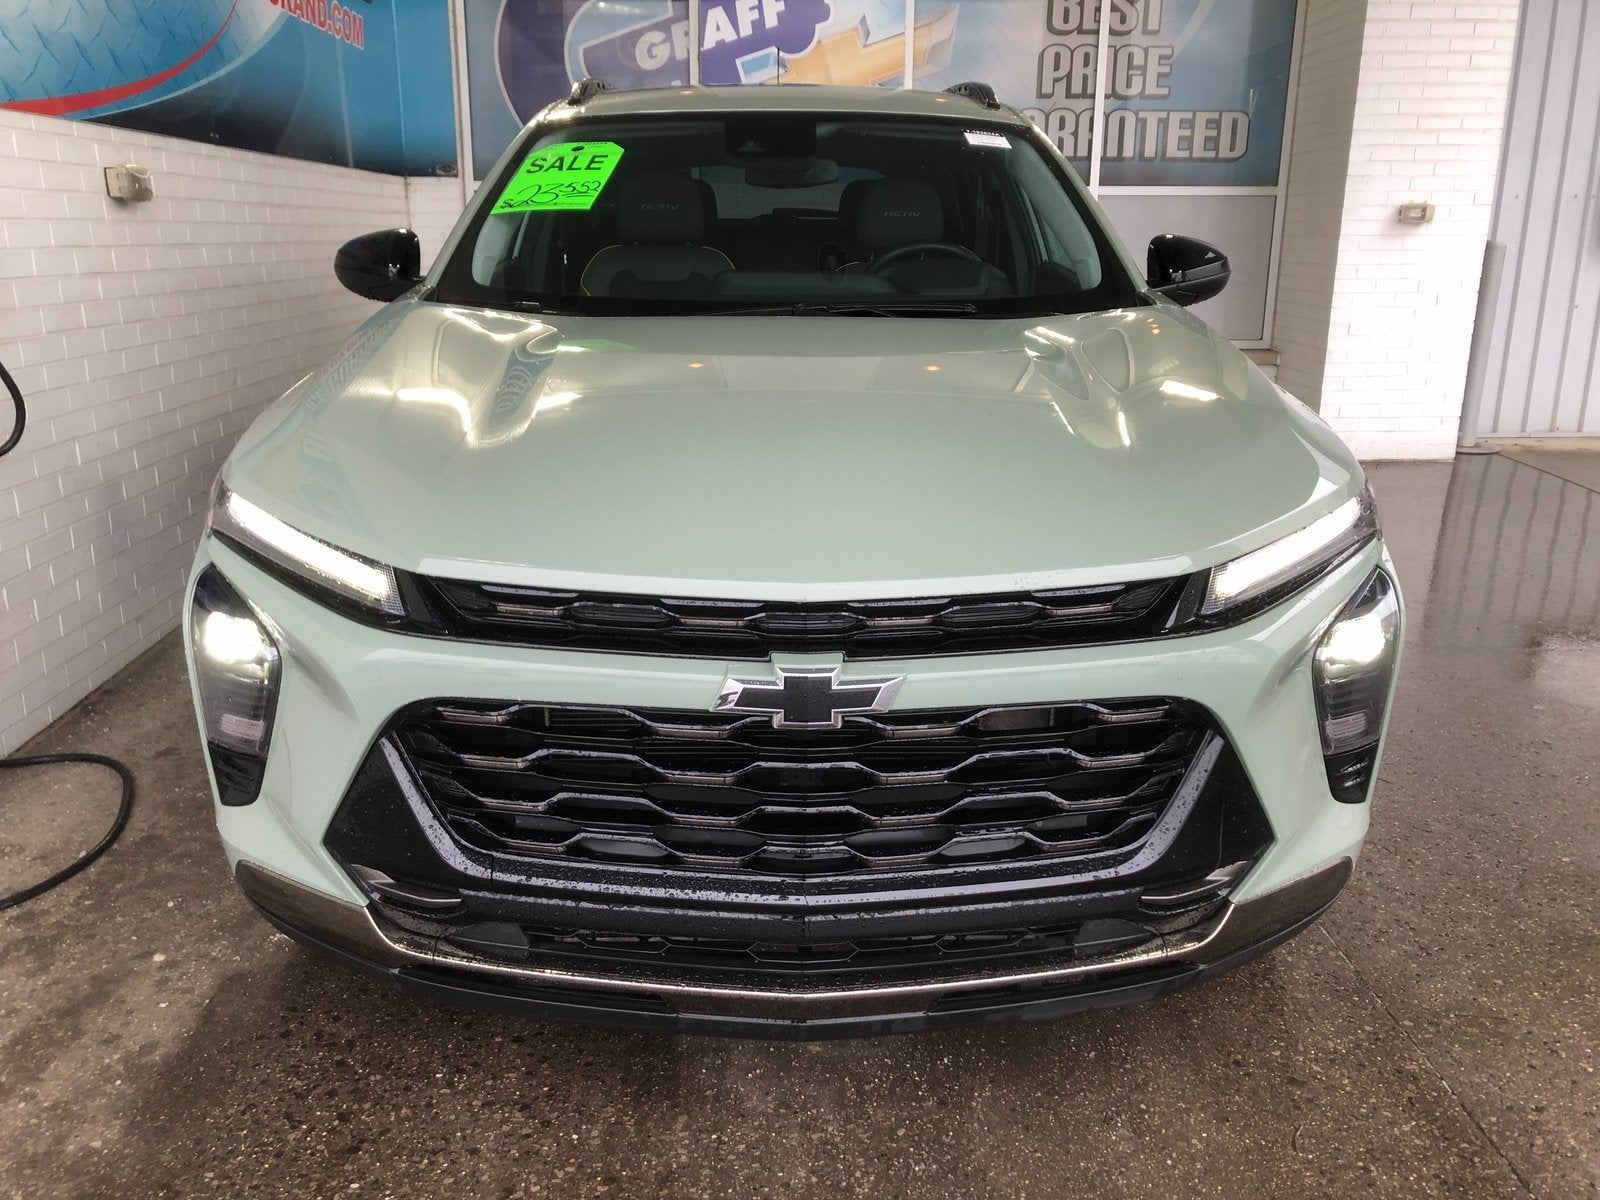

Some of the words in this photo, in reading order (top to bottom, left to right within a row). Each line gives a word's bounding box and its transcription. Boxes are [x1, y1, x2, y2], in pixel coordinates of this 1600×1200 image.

[635, 0, 786, 71] GRAFF
[1036, 43, 1174, 99] PRICE
[526, 154, 608, 174] SALE
